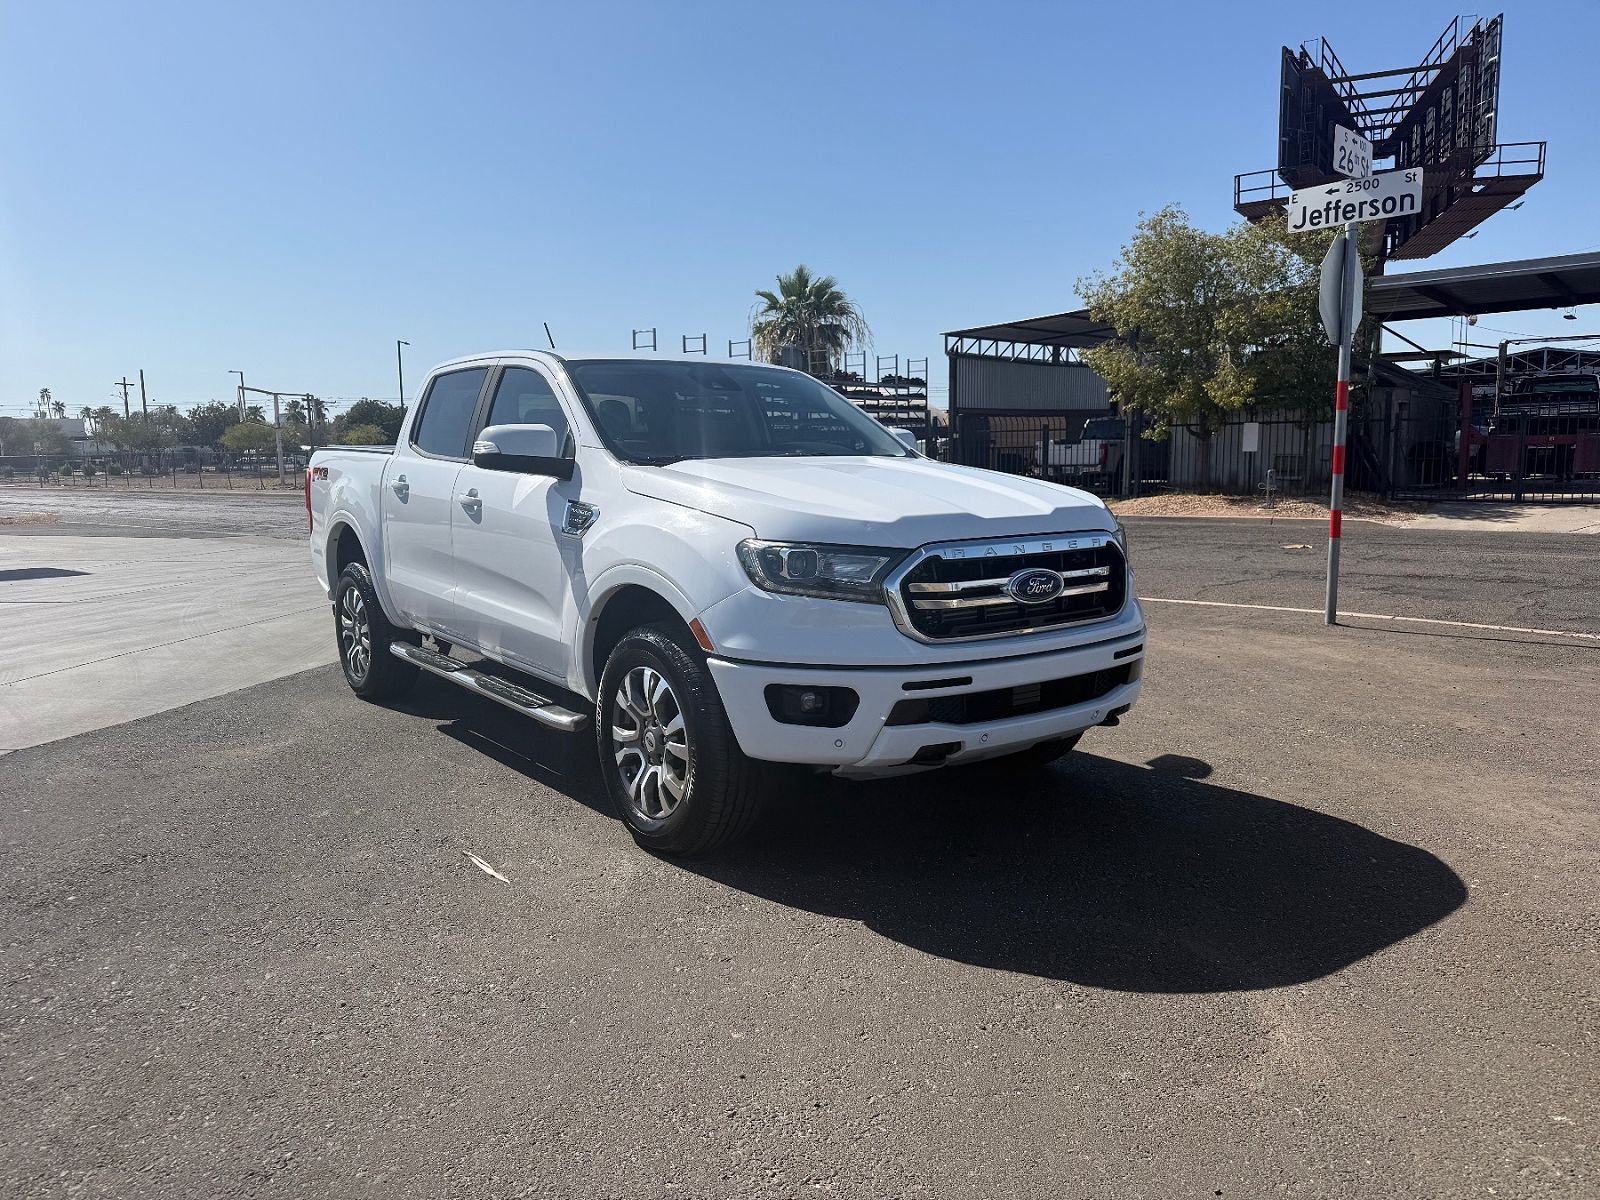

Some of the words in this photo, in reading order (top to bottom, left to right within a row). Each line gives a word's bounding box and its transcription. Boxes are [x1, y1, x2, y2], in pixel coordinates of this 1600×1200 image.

[1345, 132, 1349, 143] S
[1361, 156, 1370, 178] St
[1291, 194, 1299, 204] E
[1346, 178, 1380, 194] 2500
[1404, 172, 1417, 183] St
[1292, 193, 1415, 230] Jefferson
[951, 538, 1101, 558] RANGER
[1026, 577, 1054, 594] Ford
